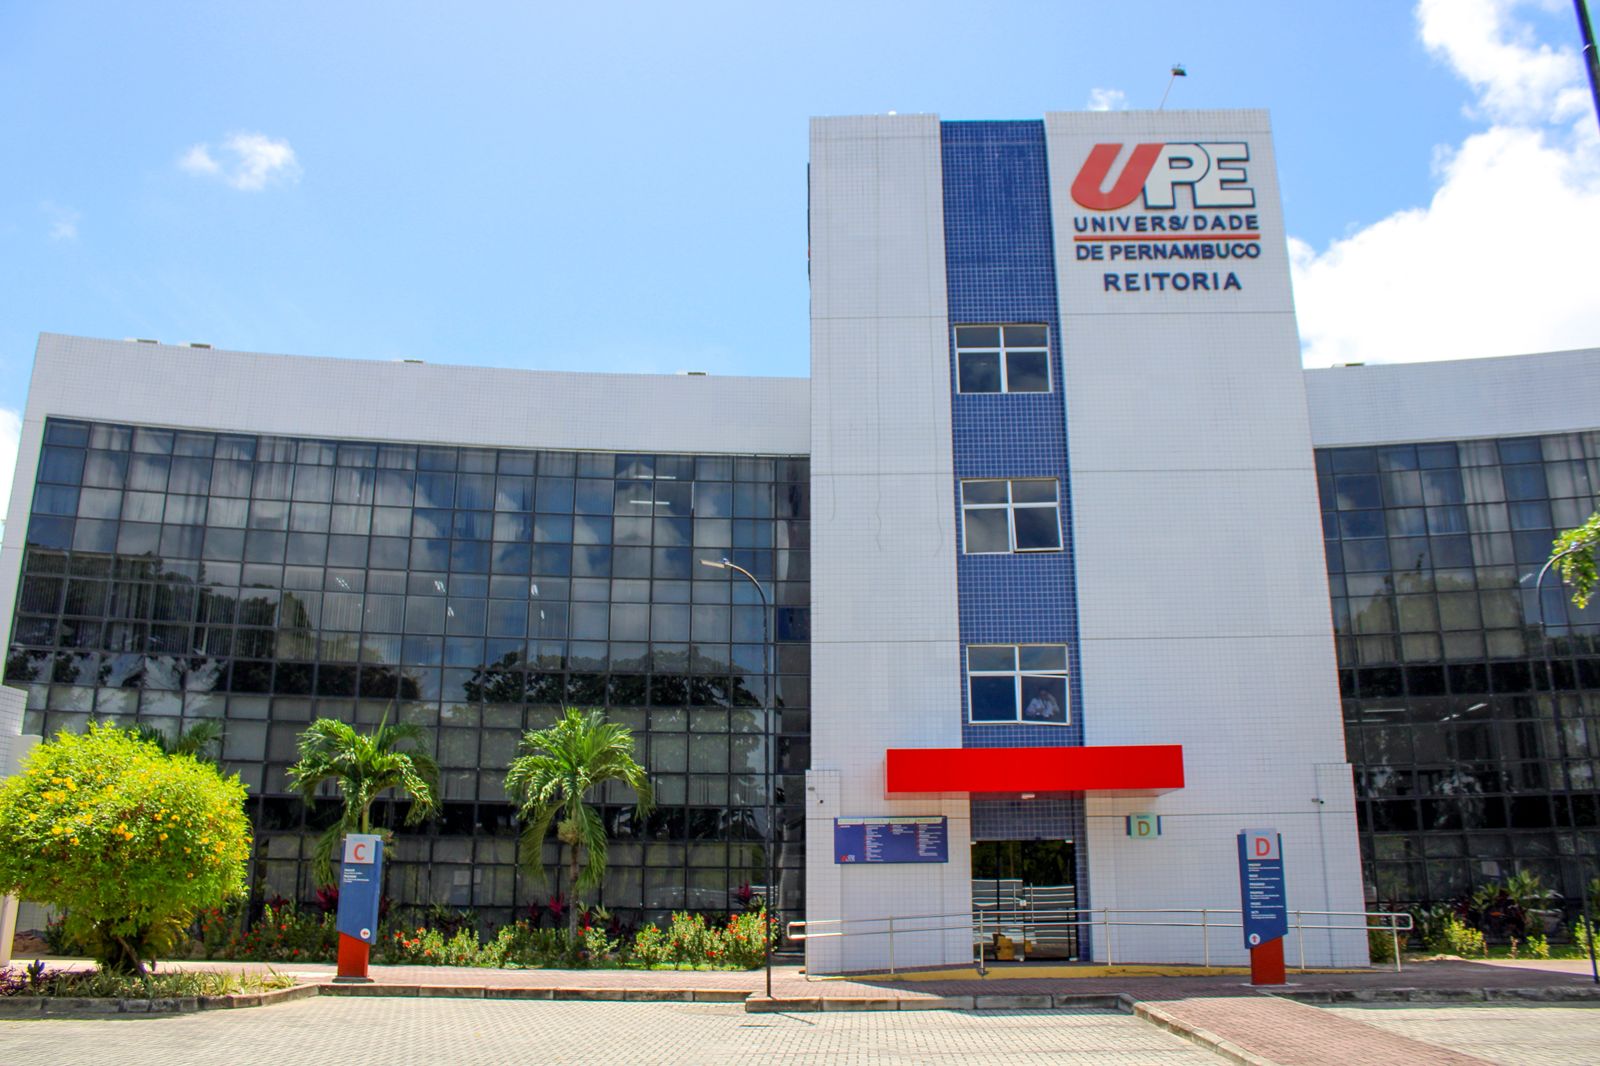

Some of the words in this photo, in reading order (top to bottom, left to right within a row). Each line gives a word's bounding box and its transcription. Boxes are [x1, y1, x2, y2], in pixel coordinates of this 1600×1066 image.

[1071, 141, 1255, 211] UPE
[1076, 244, 1104, 260] DE
[1110, 243, 1261, 260] PERNAMBUCO
[1104, 272, 1242, 291] REITORIA
[1138, 821, 1150, 836] D
[353, 843, 366, 861] C
[1255, 837, 1270, 857] D
